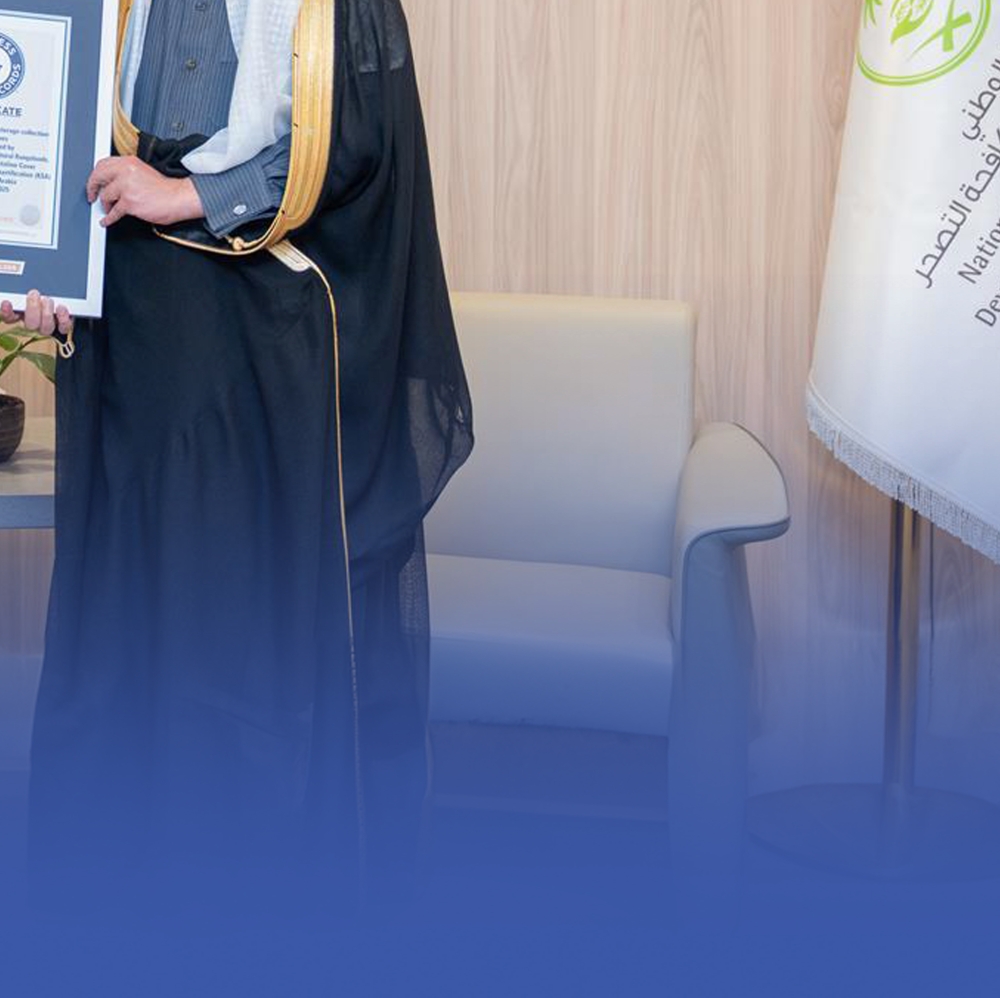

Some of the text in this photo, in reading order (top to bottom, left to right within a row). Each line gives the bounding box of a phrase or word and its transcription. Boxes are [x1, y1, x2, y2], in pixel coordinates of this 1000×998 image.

[962, 58, 1000, 141] وطني
[19, 162, 36, 170] Cover
[915, 200, 972, 289] التصحر
[957, 217, 1000, 285] Natio
